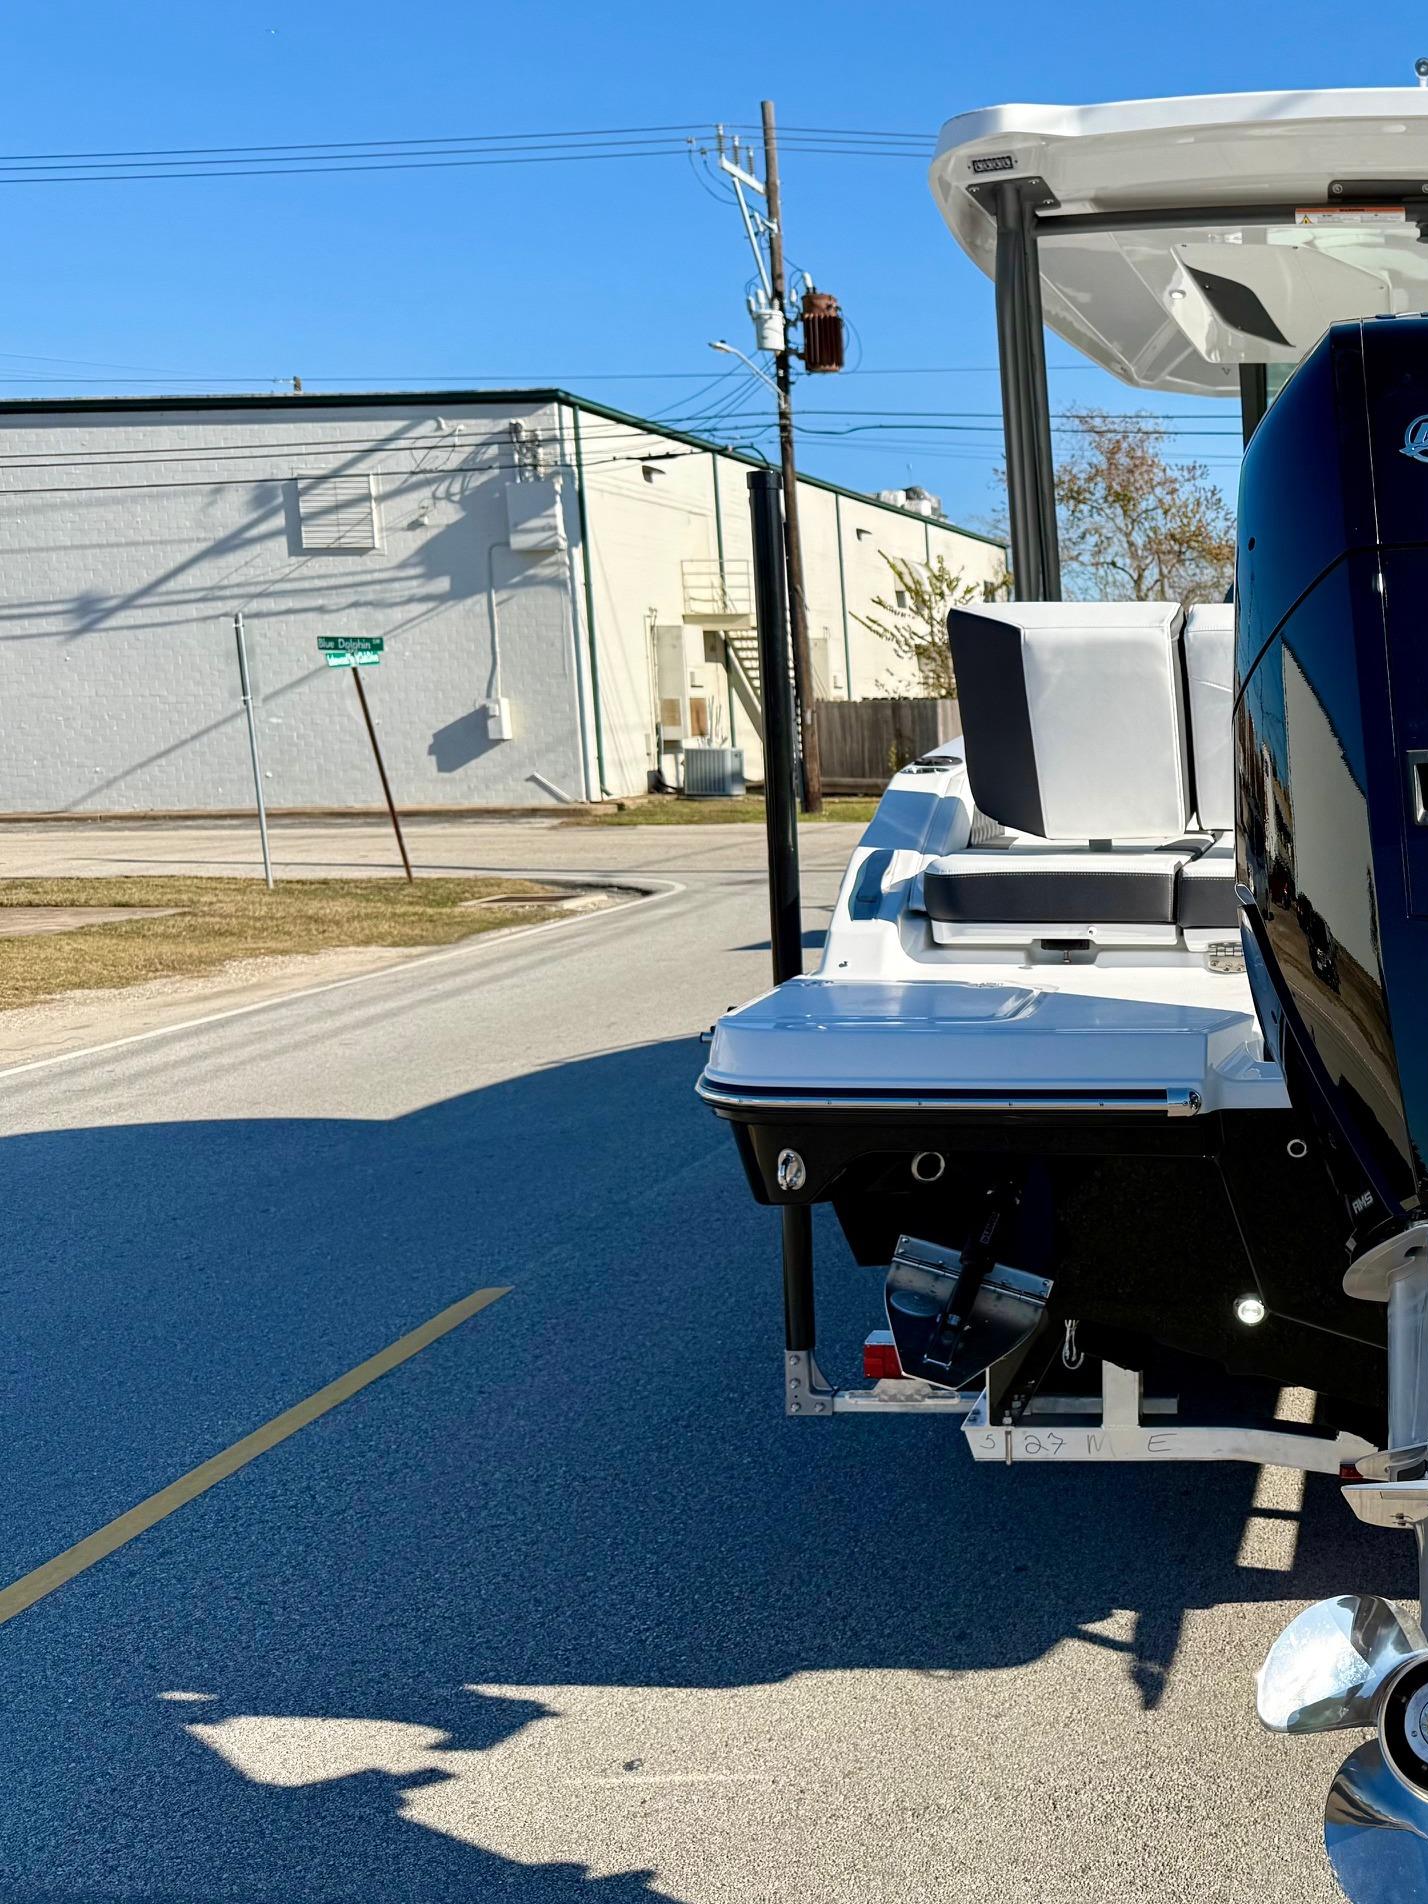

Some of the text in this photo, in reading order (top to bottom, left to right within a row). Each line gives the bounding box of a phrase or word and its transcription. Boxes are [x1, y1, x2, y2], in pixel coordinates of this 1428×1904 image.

[318, 638, 335, 649] Blue
[338, 638, 371, 651] Dolphin
[1024, 1432, 1067, 1455] 27
[1147, 1433, 1178, 1453] E
